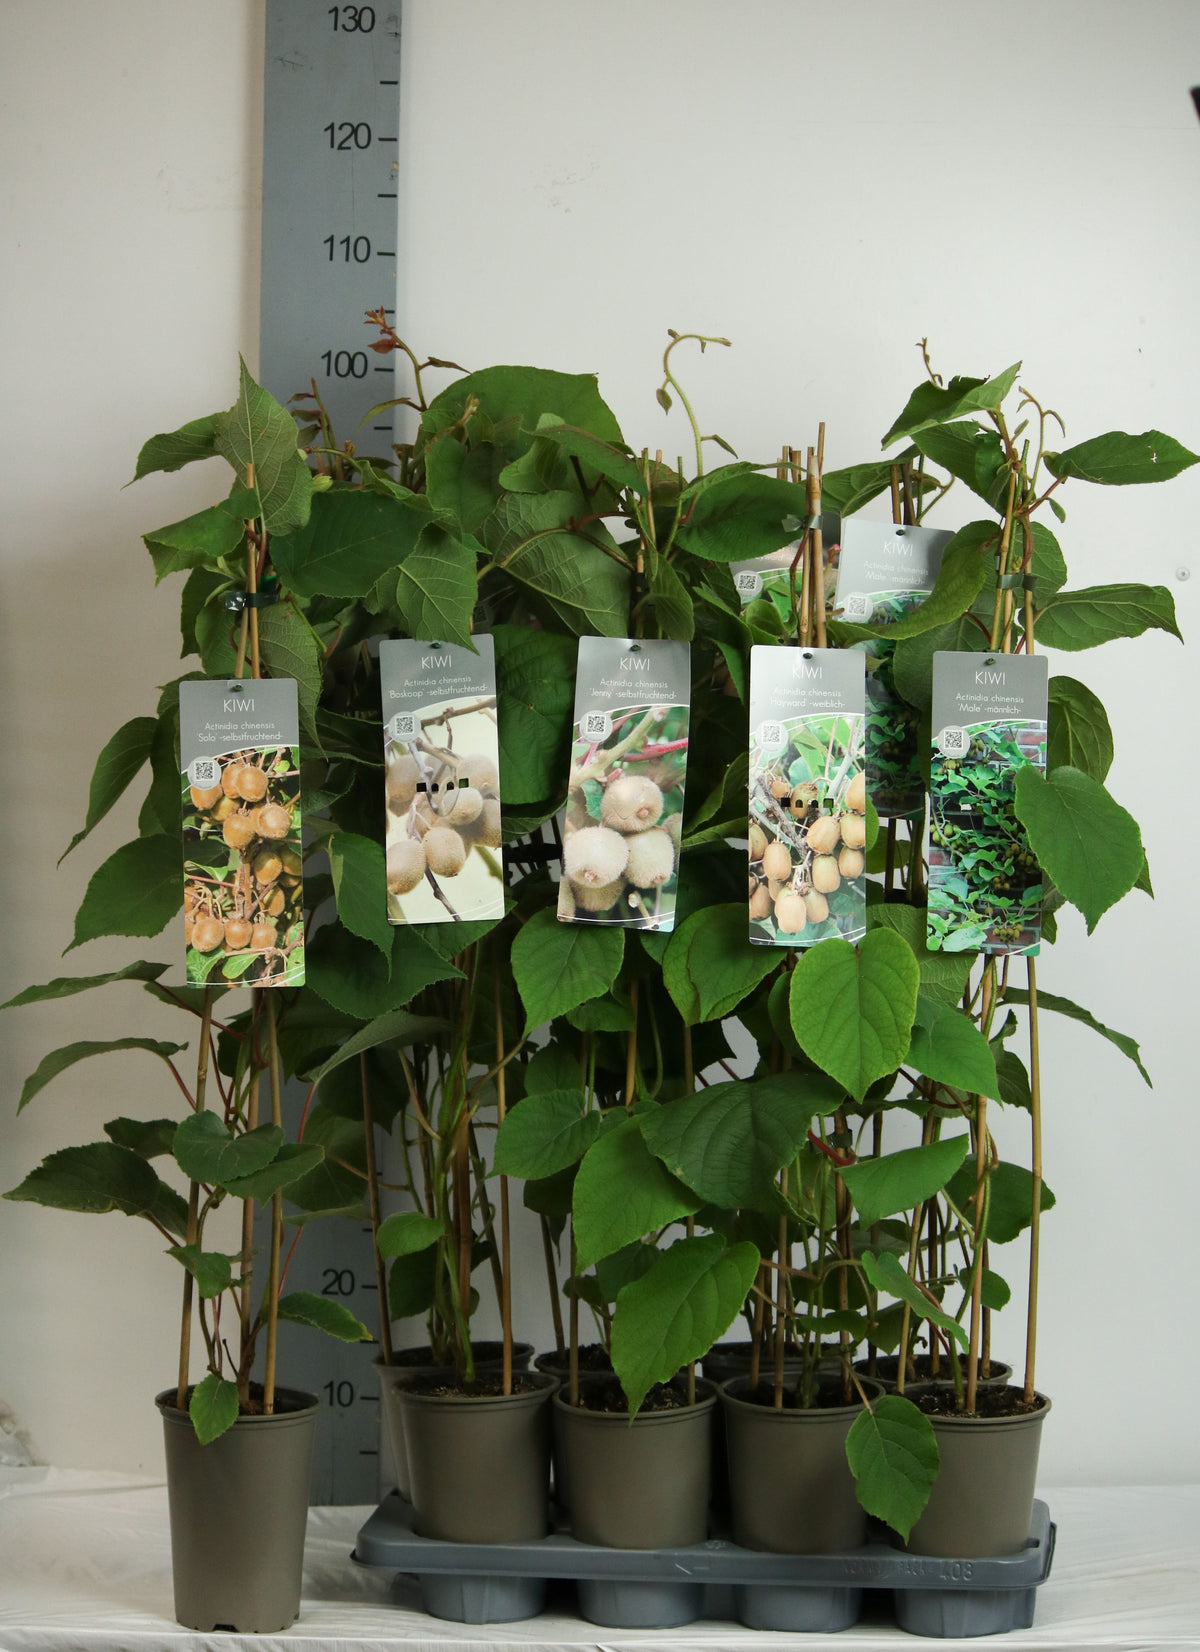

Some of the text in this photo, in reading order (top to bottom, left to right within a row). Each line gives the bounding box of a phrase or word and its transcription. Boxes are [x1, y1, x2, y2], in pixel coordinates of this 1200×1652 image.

[328, 6, 376, 33] 130
[323, 122, 371, 150] 120
[323, 234, 371, 263] 110
[321, 350, 368, 378] 100
[883, 541, 913, 557] KIWI
[421, 655, 452, 669] KIWI
[620, 657, 650, 671] KIWI
[792, 663, 823, 680] KIWI
[975, 671, 1006, 685] KIWI
[404, 675, 472, 687] Actinidia chinensis
[599, 678, 668, 689] Actinidia chinensis
[808, 687, 842, 697] chinensis
[955, 692, 1025, 704] Actinidia chinensis
[223, 699, 255, 713] KIWI
[204, 720, 275, 730] Actinidia chinensis
[321, 1268, 355, 1296] 20
[323, 1380, 354, 1407] 10
